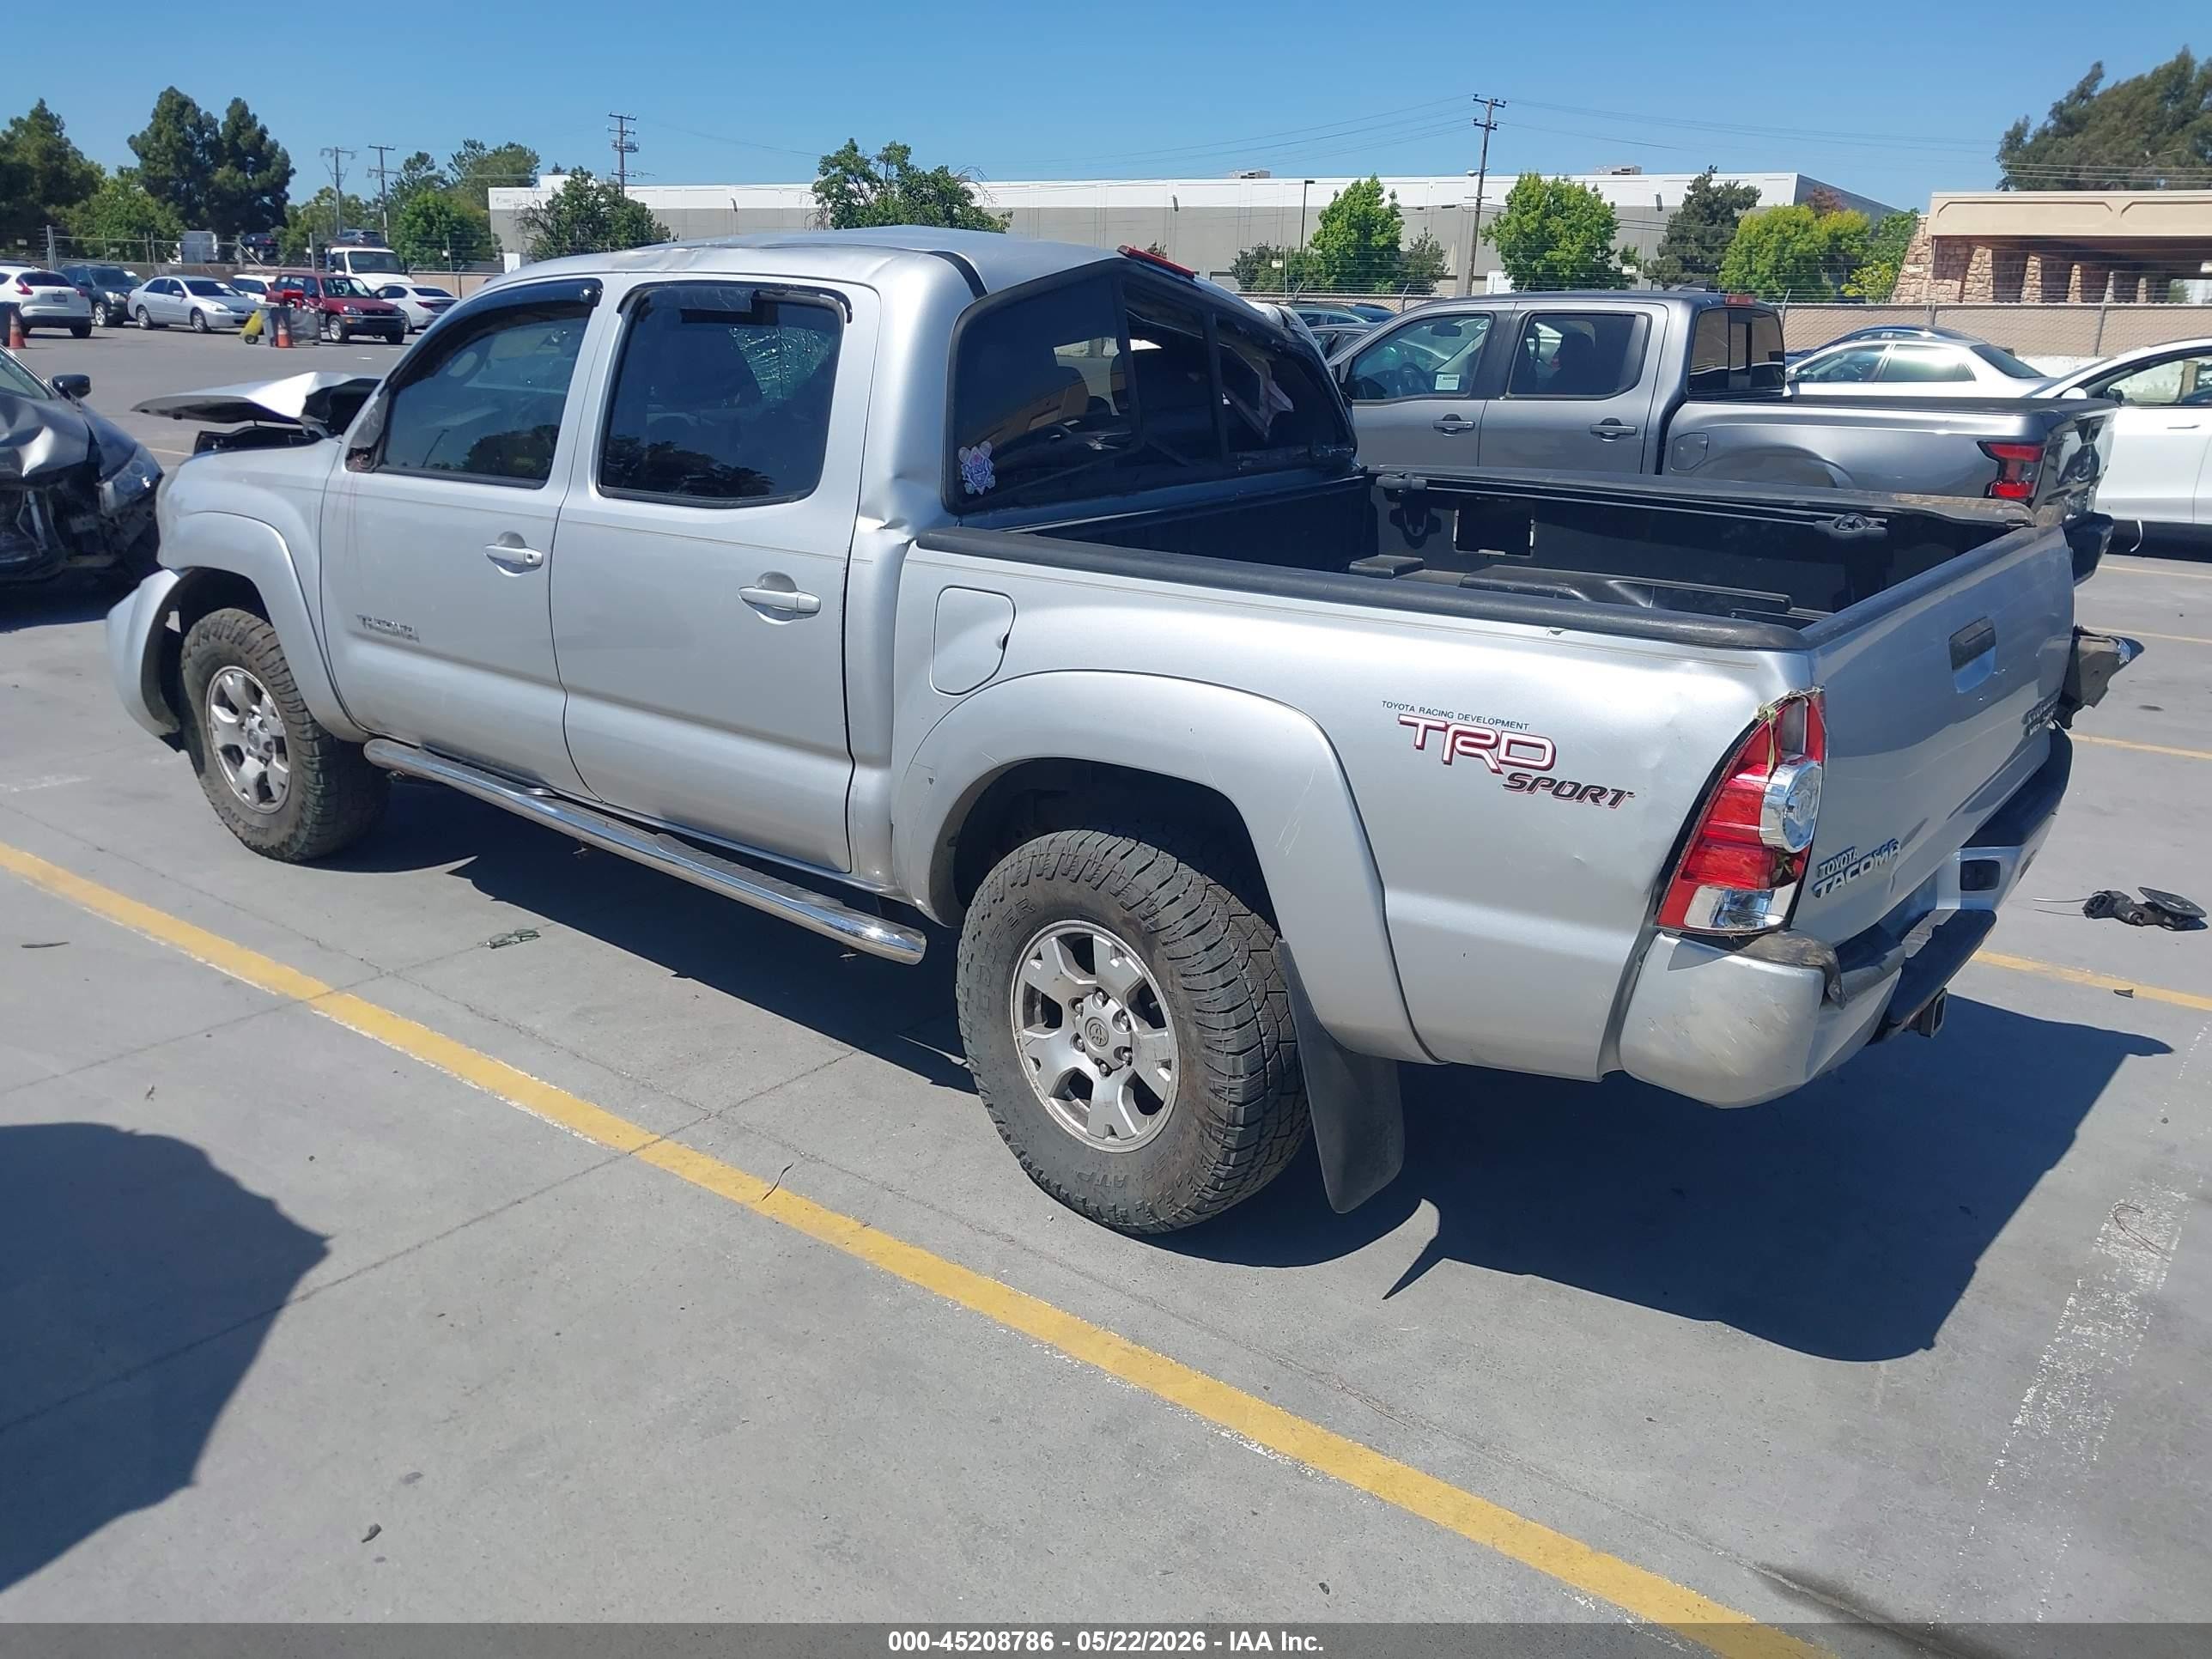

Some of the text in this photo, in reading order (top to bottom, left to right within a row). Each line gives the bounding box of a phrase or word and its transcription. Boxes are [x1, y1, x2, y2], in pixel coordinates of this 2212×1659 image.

[1382, 700, 1529, 731] TOYOTA RACING DEVELOPMENT
[1398, 714, 1557, 775] TRD
[1502, 772, 1635, 809] SPORT
[1813, 838, 1900, 898] TACOMA
[1818, 847, 1859, 877] TOYOTA
